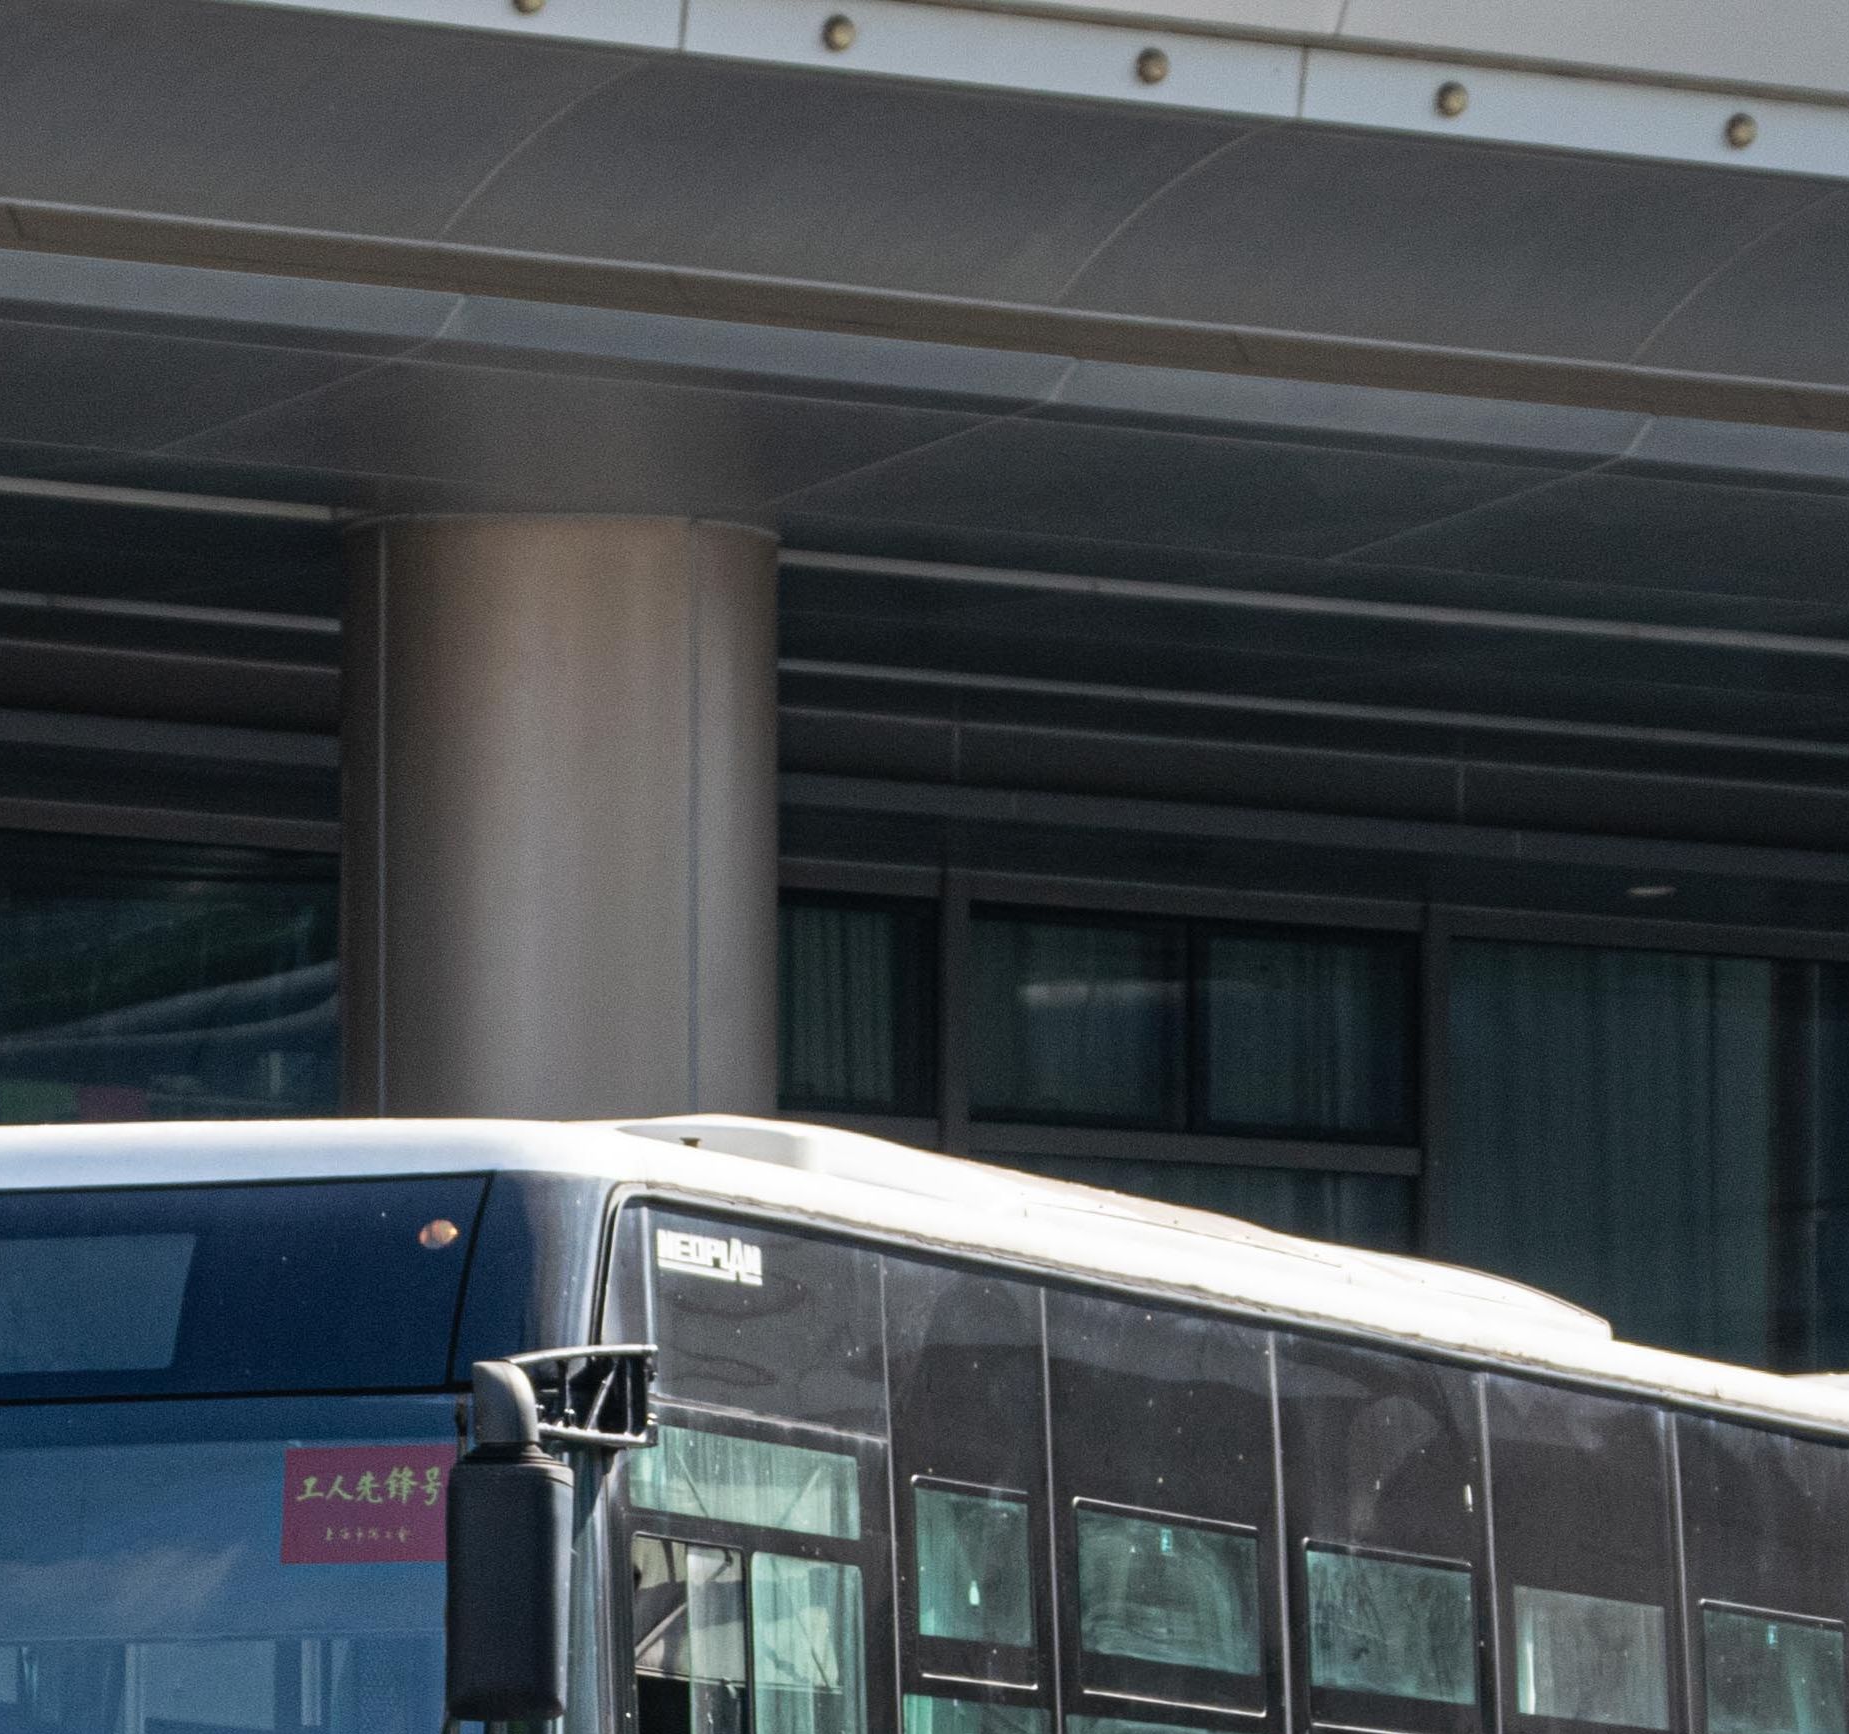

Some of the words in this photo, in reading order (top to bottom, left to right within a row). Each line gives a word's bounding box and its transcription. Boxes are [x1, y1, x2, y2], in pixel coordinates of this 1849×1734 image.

[296, 1466, 441, 1505] 工人先锋号
